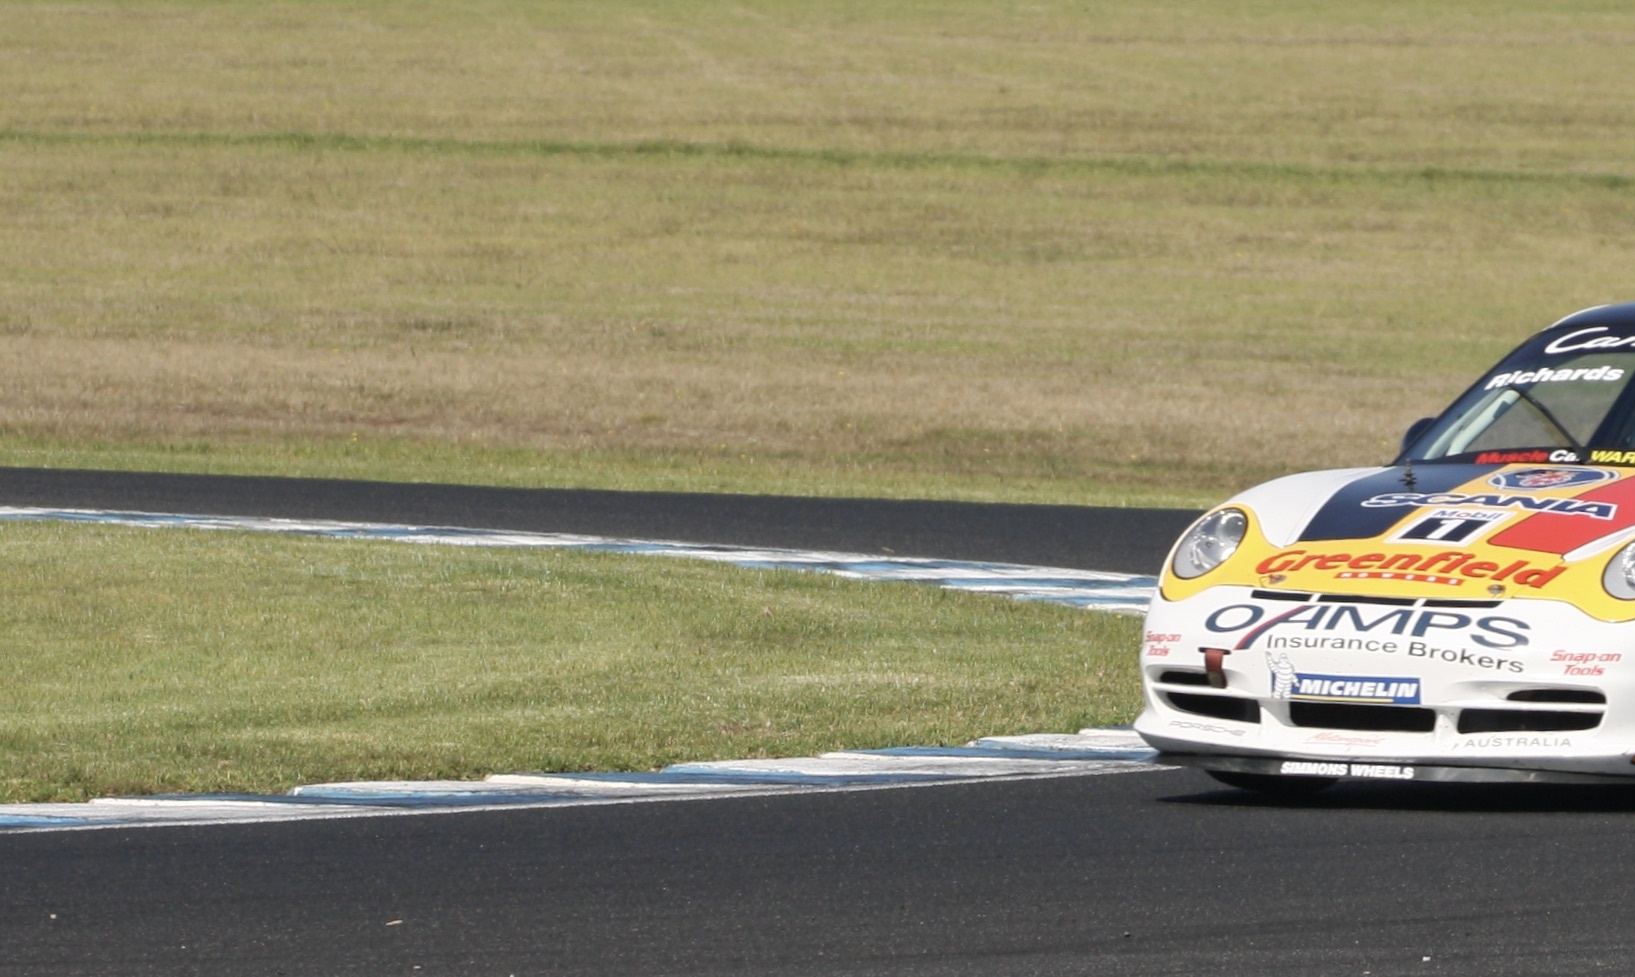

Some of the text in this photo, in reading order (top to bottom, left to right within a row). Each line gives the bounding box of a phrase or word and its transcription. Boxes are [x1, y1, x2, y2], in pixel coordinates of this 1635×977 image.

[1484, 365, 1625, 390] Richards
[1549, 449, 1580, 463] Ca
[1361, 493, 1618, 521] SCANIA
[1433, 510, 1504, 520] Mobil
[1255, 550, 1569, 588] Greenfield
[1266, 634, 1525, 674] Insurance Brokers
[1550, 649, 1622, 663] Snap-on
[1563, 665, 1606, 676] Tools
[1299, 679, 1418, 698] MICHELIN
[1168, 721, 1247, 736] PORSCHE
[1464, 737, 1572, 748] AUSTRALIA
[1280, 761, 1415, 779] SIMMONS WHEELS
